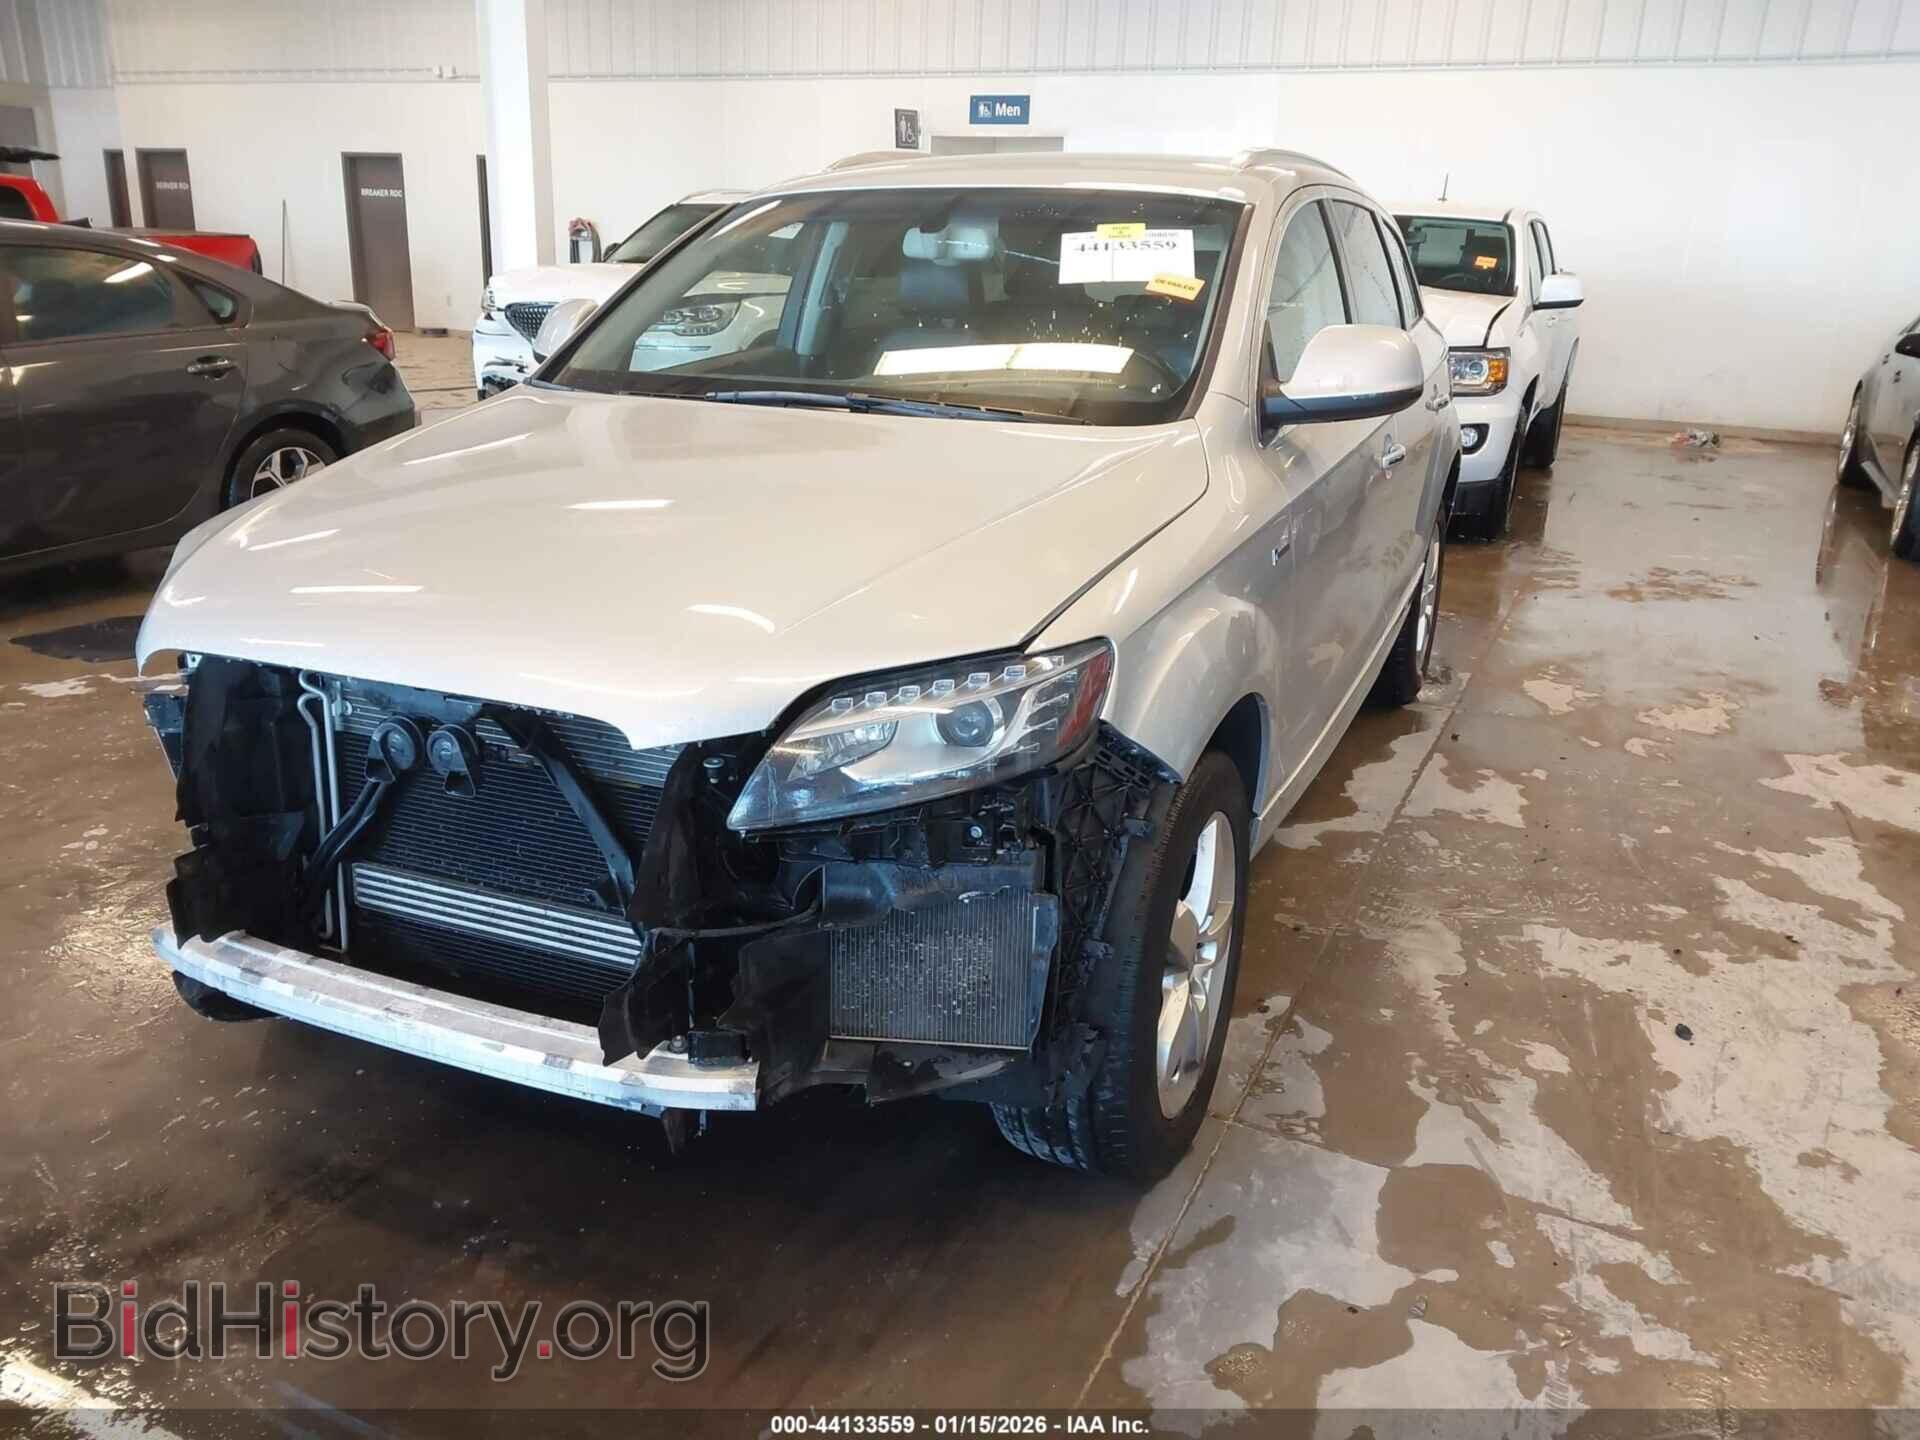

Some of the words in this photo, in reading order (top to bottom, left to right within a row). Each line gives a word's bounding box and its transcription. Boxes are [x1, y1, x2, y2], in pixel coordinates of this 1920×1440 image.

[995, 103, 1021, 117] Men
[361, 188, 388, 197] BREAKER
[1073, 240, 1177, 253] 44133559
